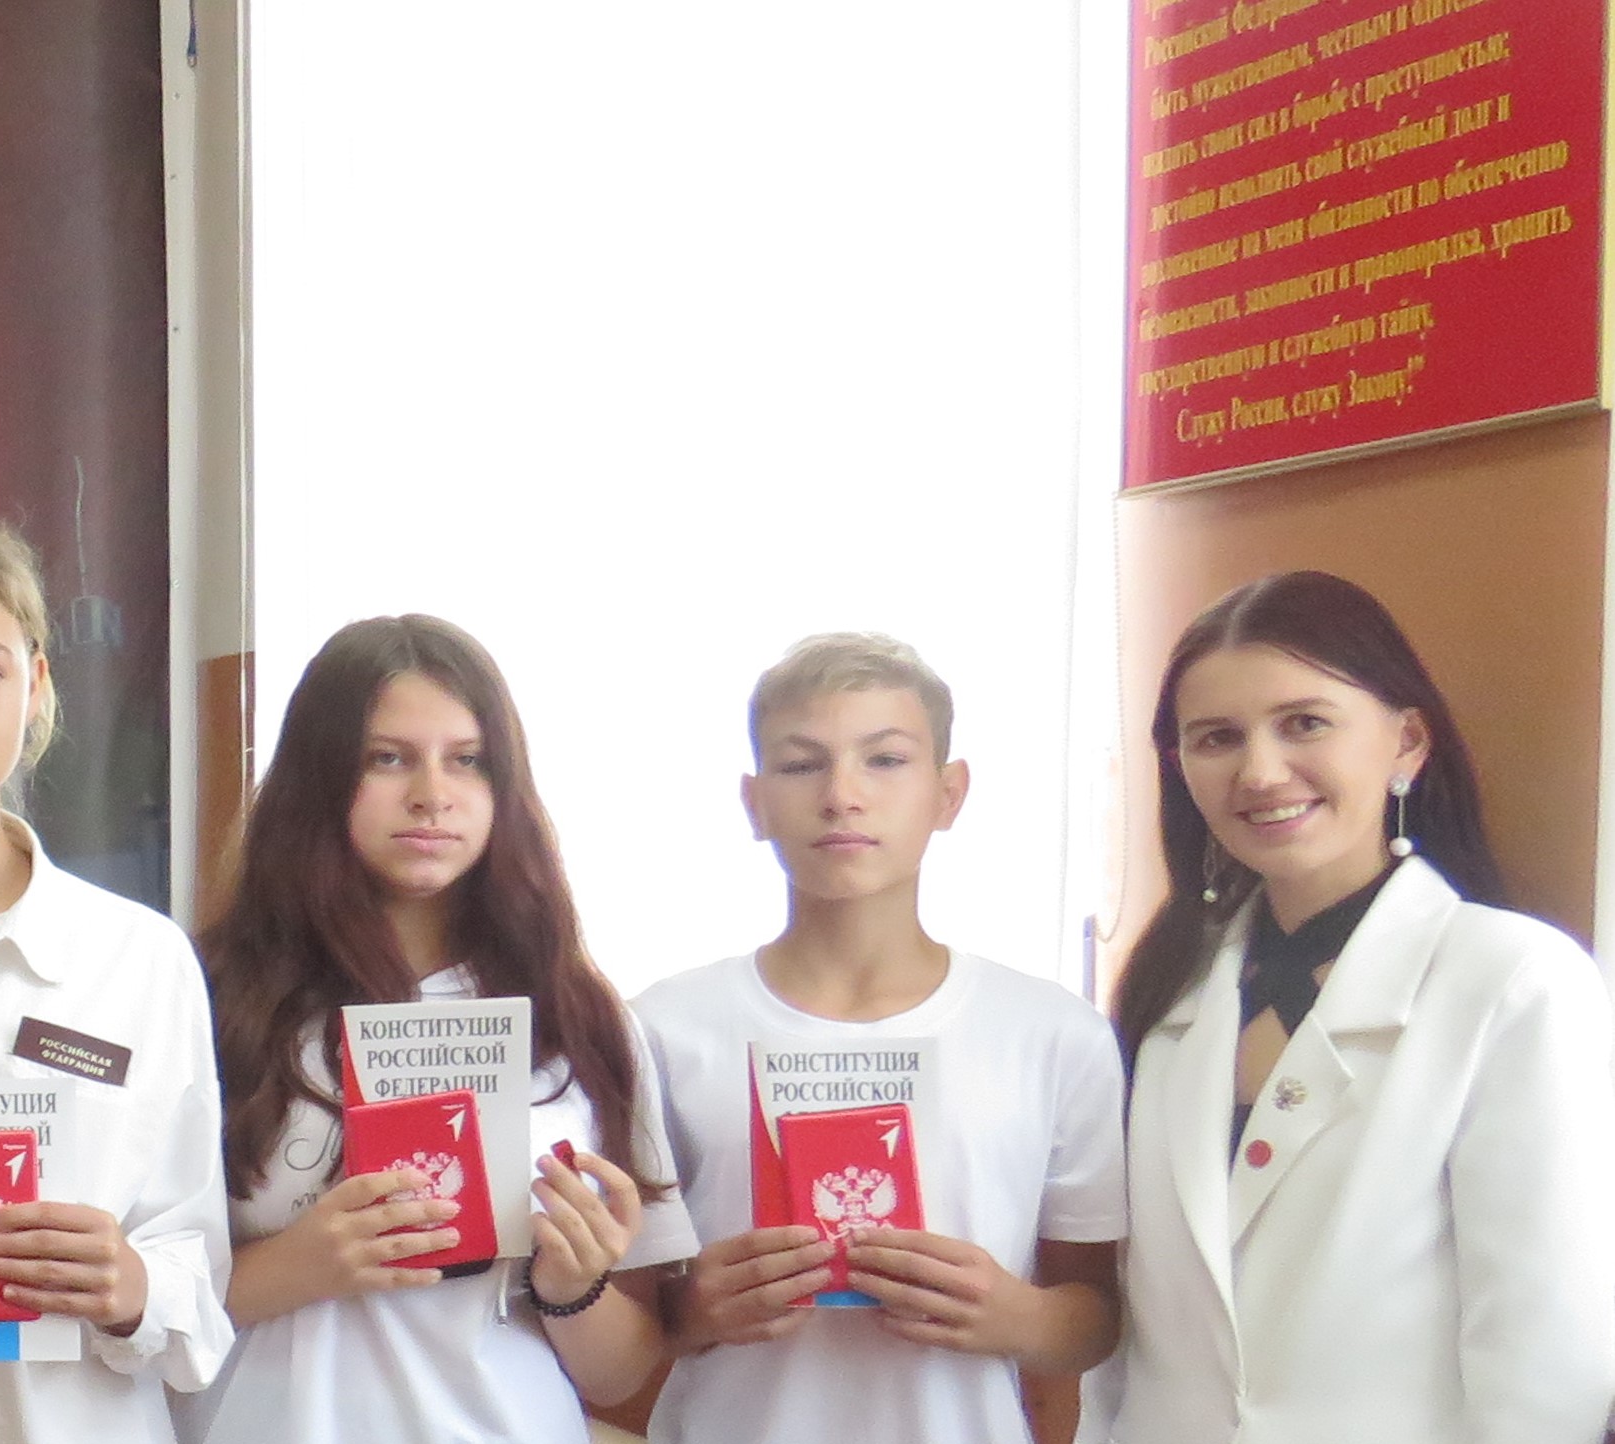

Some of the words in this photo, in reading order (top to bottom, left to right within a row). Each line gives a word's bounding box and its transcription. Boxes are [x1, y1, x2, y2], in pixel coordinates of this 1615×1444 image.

[1397, 5, 1407, 32] и
[1280, 107, 1290, 133] в
[1352, 81, 1363, 108] с
[1497, 94, 1511, 122] и
[1418, 178, 1439, 207] по
[1443, 139, 1570, 200] обеспечению
[1339, 264, 1350, 289] и
[1490, 205, 1573, 258] хранить
[1283, 314, 1375, 368] служебную
[1176, 408, 1225, 447] Служу
[360, 1016, 512, 1041] КОНСТИТУЦИЯ
[39, 1037, 112, 1067] РОССИЙСКАЯ
[41, 1049, 106, 1077] ФЕДЕРАЦИЯ
[367, 1041, 506, 1069] РОССИЙСКОЙ
[766, 1052, 920, 1074] КОНСТИТУЦИЯ
[772, 1077, 914, 1102] РОССИЙСКОЙ
